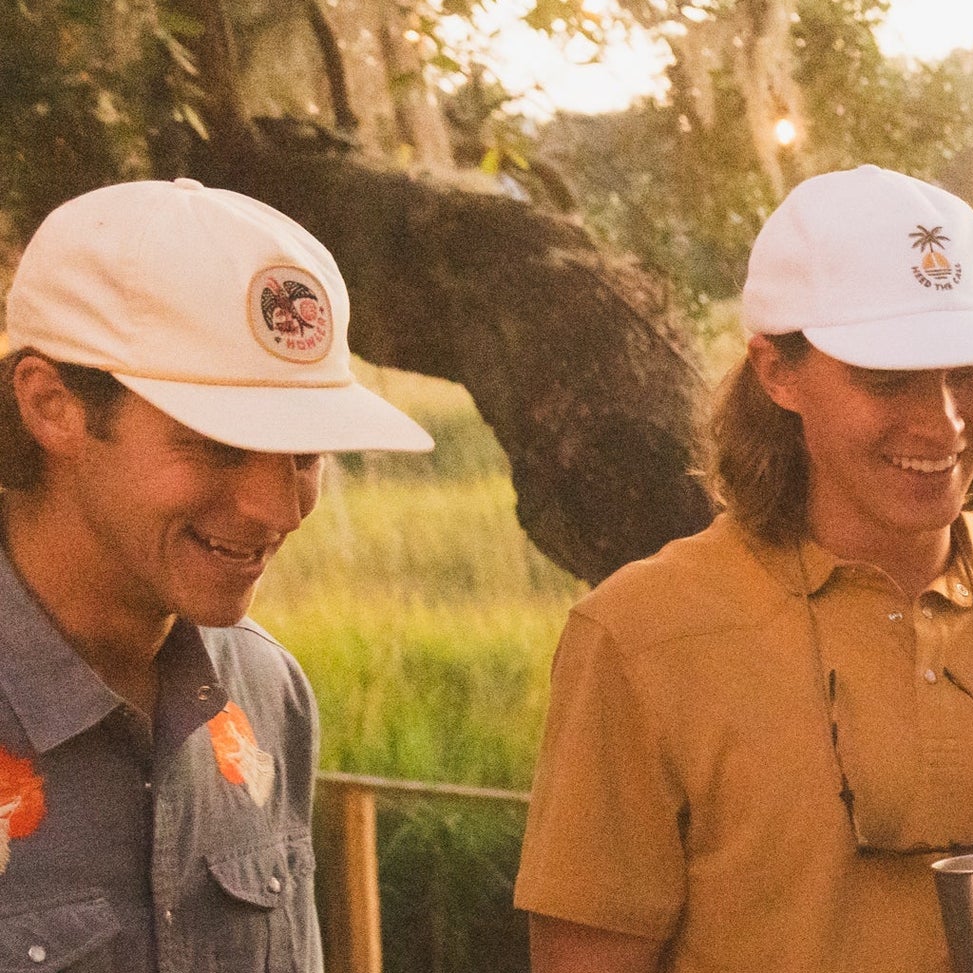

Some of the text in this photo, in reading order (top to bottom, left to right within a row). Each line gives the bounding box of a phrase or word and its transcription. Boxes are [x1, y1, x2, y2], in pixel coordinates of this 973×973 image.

[911, 263, 962, 291] HEED THE CALL
[286, 317, 327, 351] HOWLER
